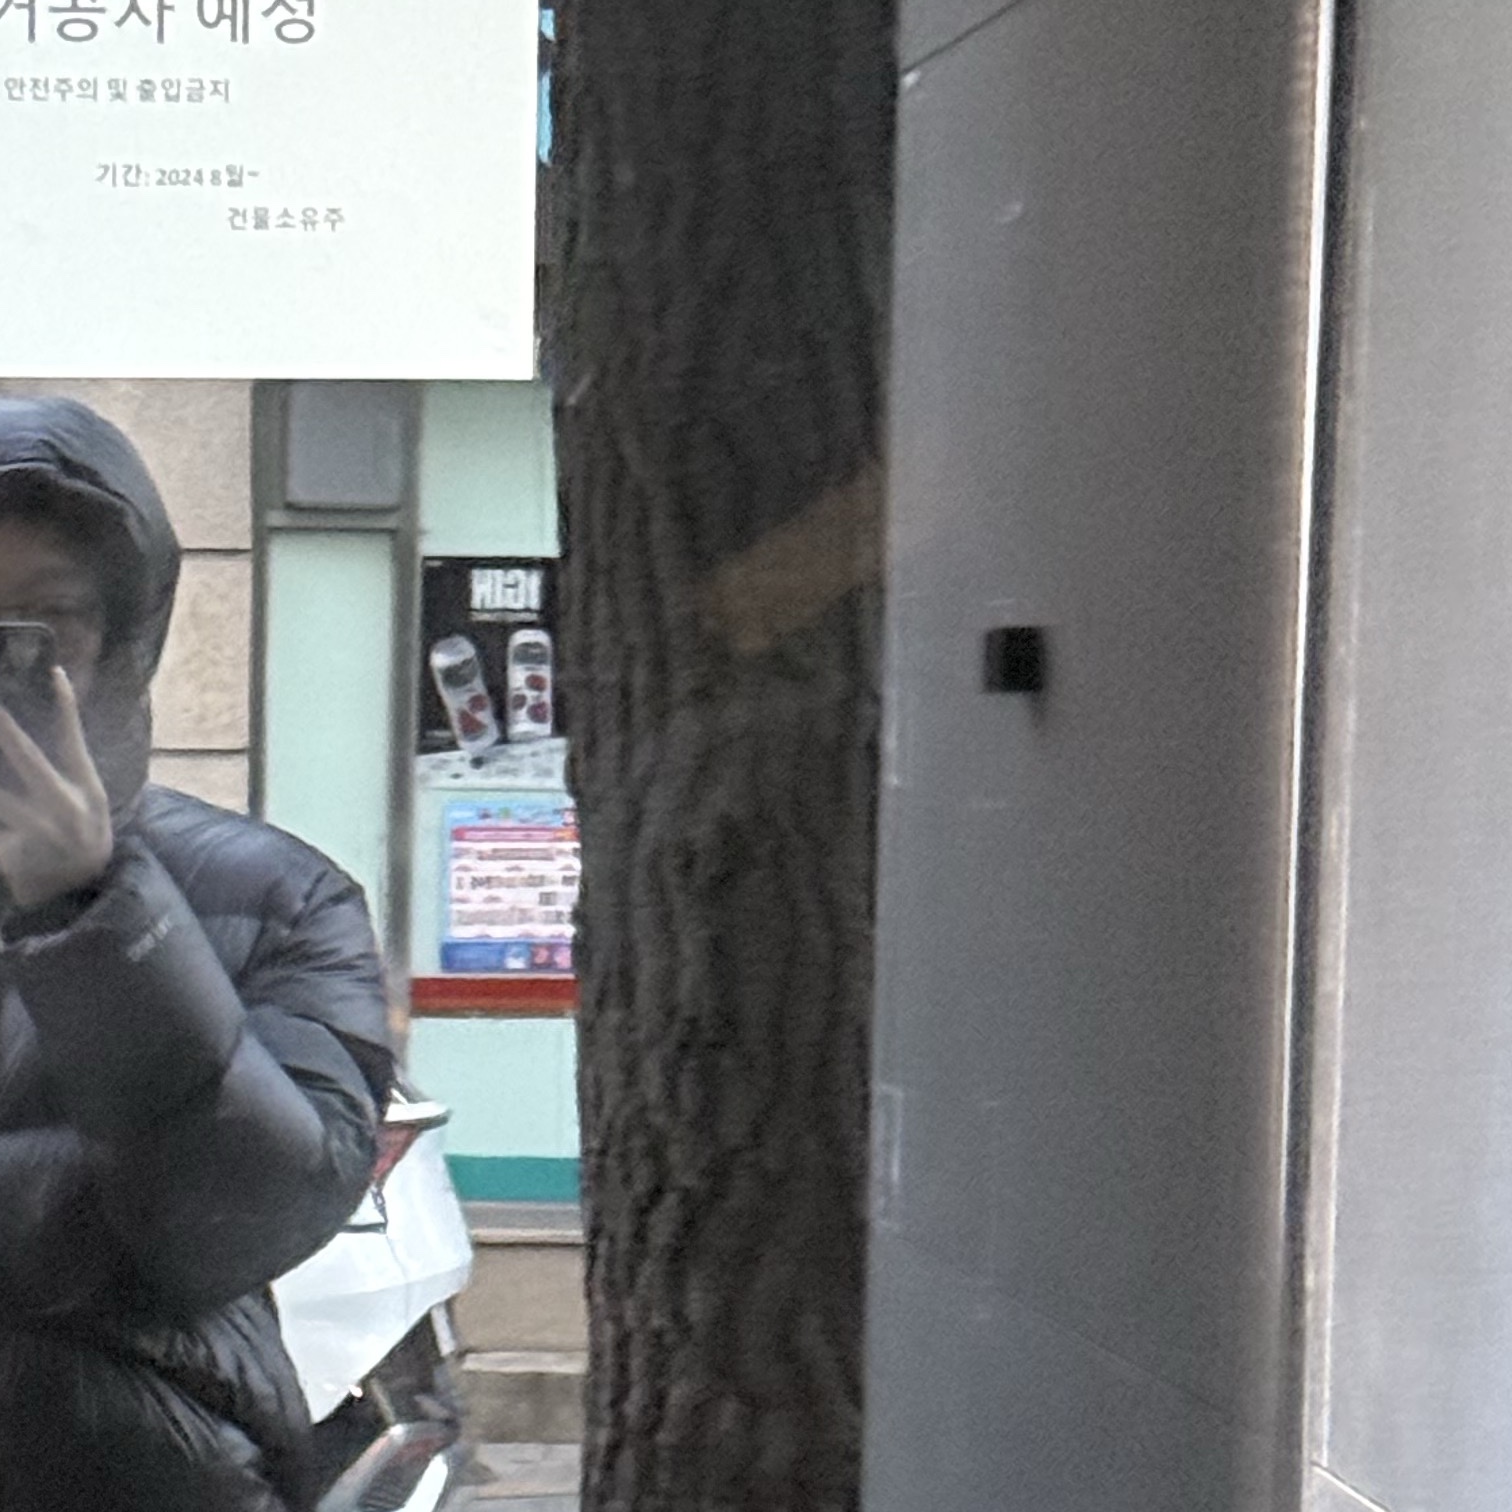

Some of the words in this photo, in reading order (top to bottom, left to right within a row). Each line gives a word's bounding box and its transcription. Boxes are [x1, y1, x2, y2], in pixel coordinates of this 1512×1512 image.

[3, 76, 98, 103] 안전주의
[106, 76, 129, 103] 및
[135, 77, 230, 104] 출입금지
[227, 205, 346, 232] 건물소유주
